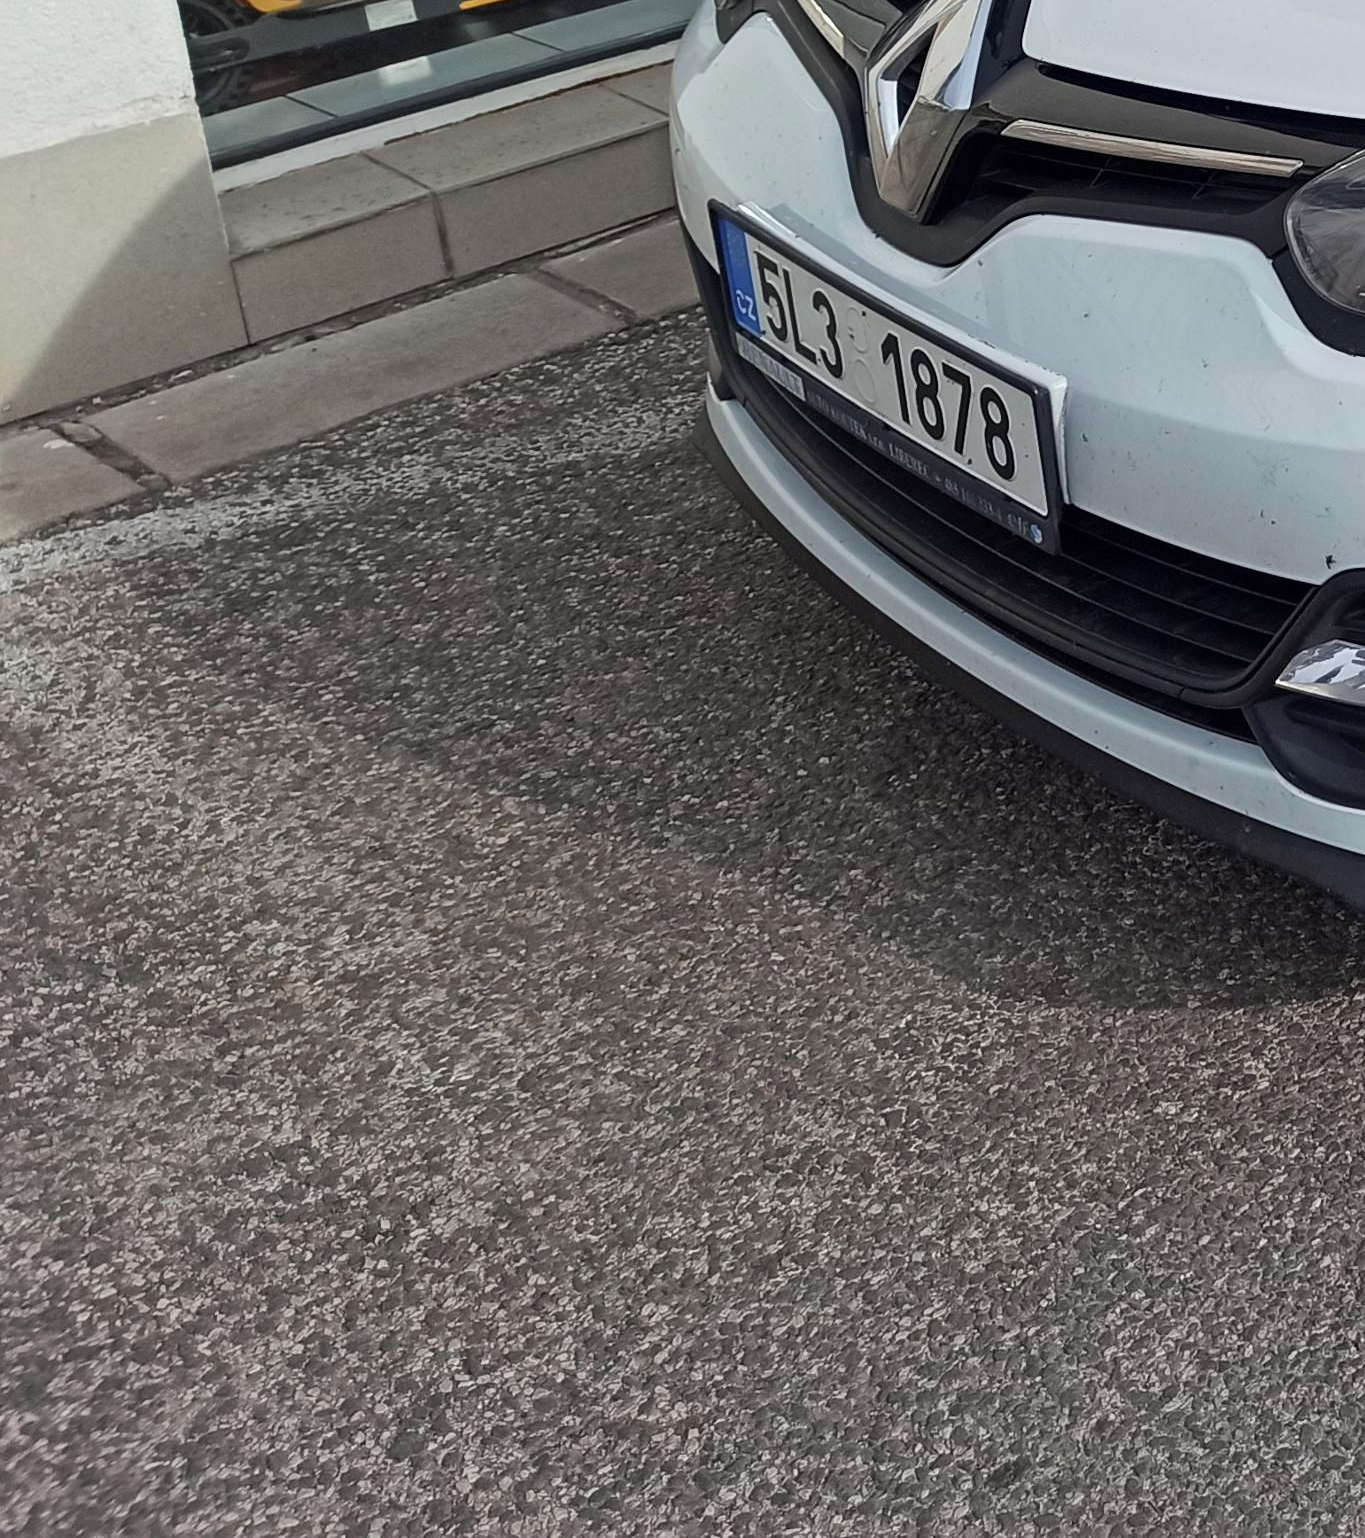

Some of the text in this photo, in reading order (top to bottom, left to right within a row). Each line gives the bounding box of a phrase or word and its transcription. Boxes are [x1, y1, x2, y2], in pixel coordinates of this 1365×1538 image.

[735, 290, 756, 321] CZ
[758, 252, 843, 379] 5L3
[881, 332, 1014, 481] 1878
